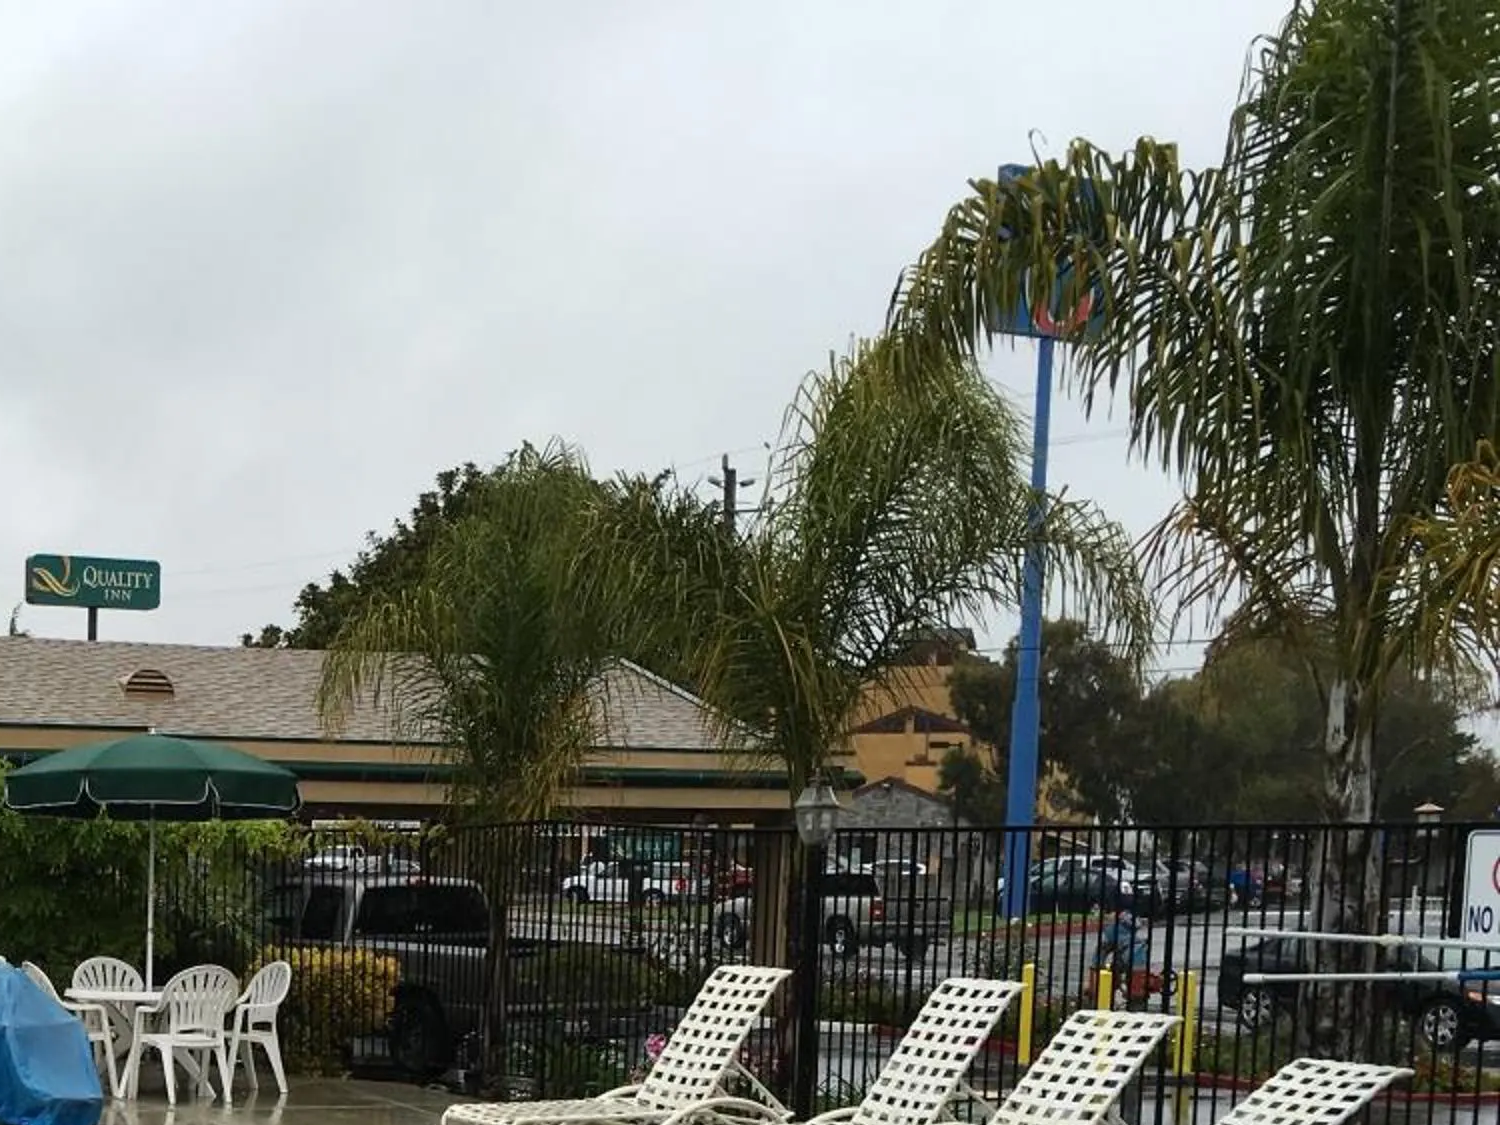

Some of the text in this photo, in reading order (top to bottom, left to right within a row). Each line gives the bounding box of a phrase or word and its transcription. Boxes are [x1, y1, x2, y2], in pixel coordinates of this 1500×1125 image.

[83, 565, 153, 589] QUALITY
[104, 589, 132, 601] INN
[1468, 905, 1493, 933] NO
